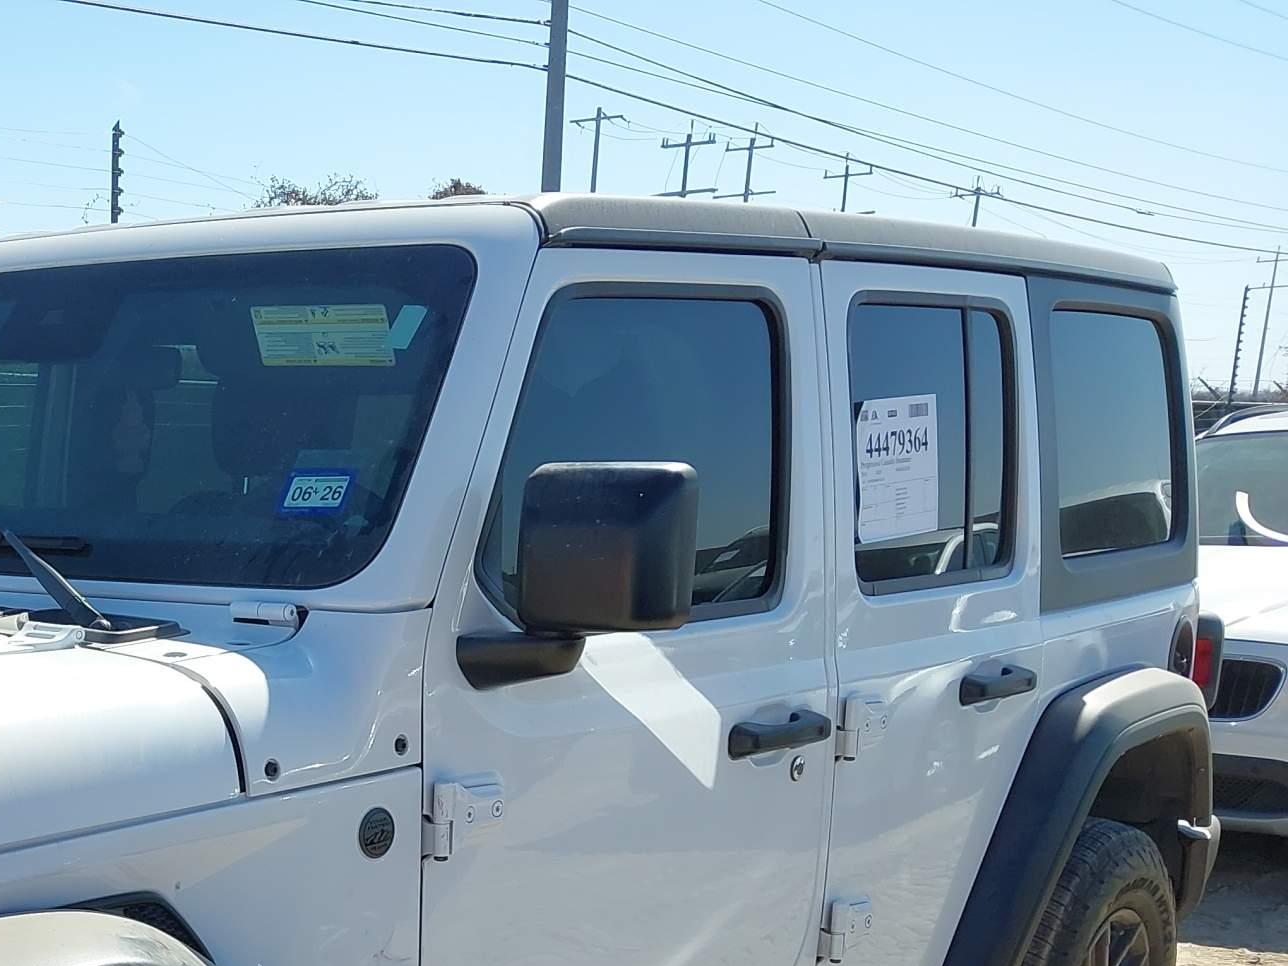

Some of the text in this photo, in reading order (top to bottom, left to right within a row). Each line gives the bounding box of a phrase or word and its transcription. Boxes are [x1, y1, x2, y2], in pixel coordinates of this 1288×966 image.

[866, 427, 929, 458] 44479364
[291, 486, 344, 501] 06 26
